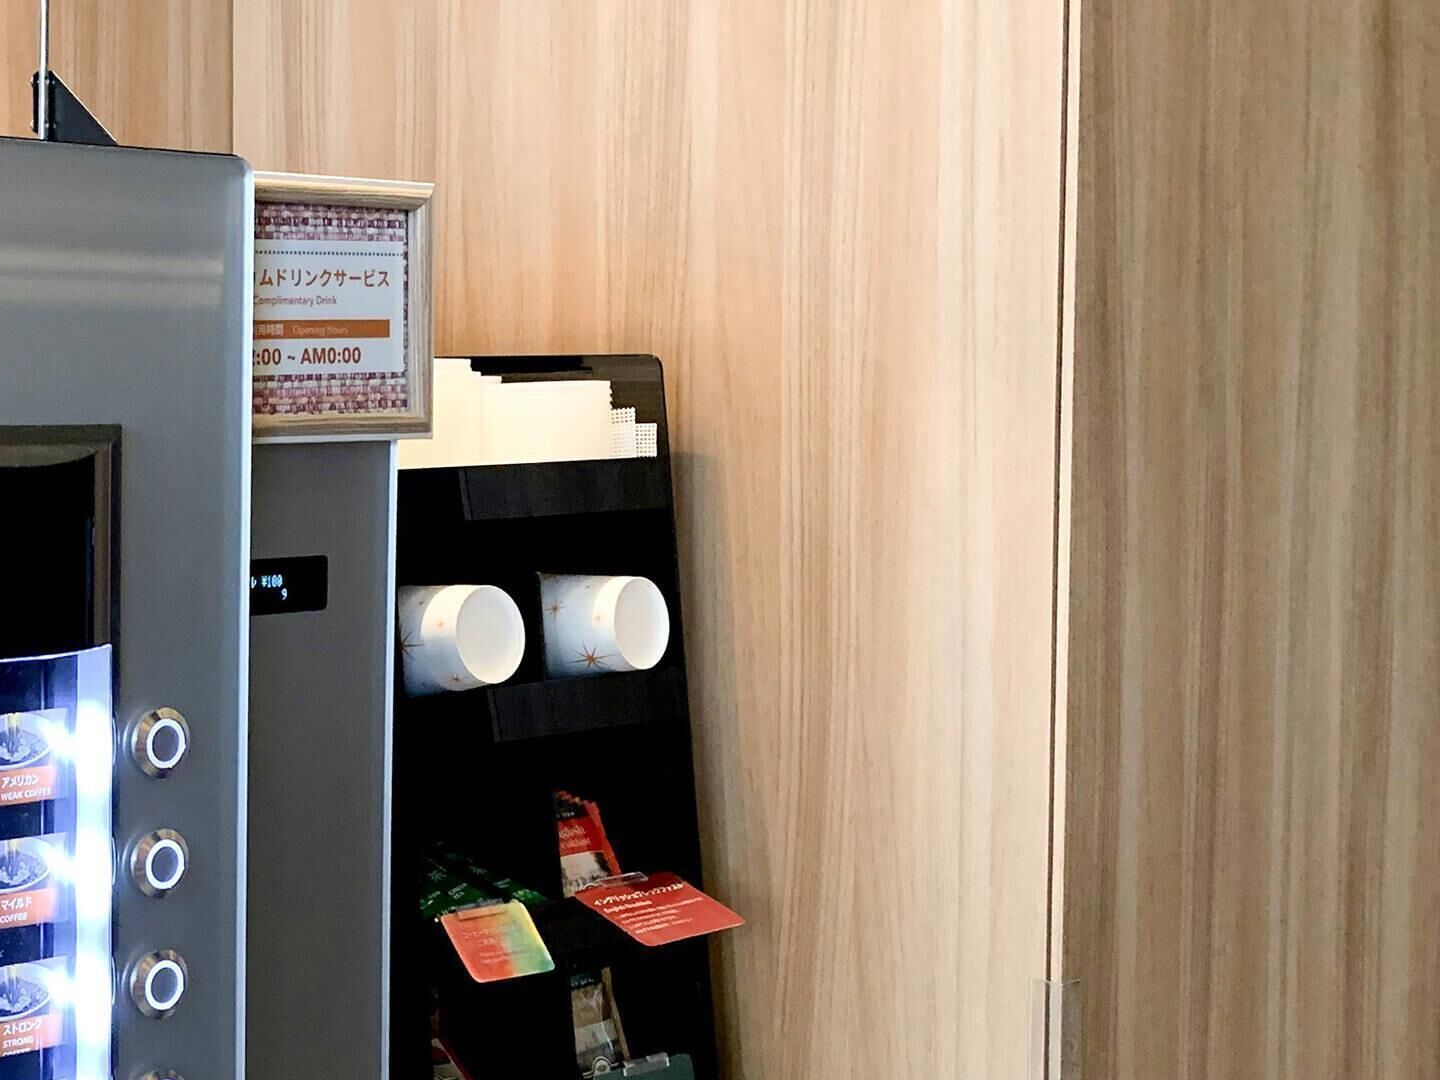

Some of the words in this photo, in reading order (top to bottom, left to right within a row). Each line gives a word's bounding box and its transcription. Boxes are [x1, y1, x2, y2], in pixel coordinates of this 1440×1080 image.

[260, 268, 390, 288] ムドリンクサービス
[253, 295, 314, 307] Complimentary
[316, 295, 337, 305] Drink
[300, 346, 362, 365] AM0:00
[1, 774, 40, 790] アメリカン
[1, 791, 26, 802] WEAK
[26, 788, 53, 799] COFFEE
[0, 897, 33, 912] マイルド
[0, 912, 28, 925] COFFEE
[2, 1018, 43, 1037] ストロング
[2, 1036, 35, 1050] STRONG
